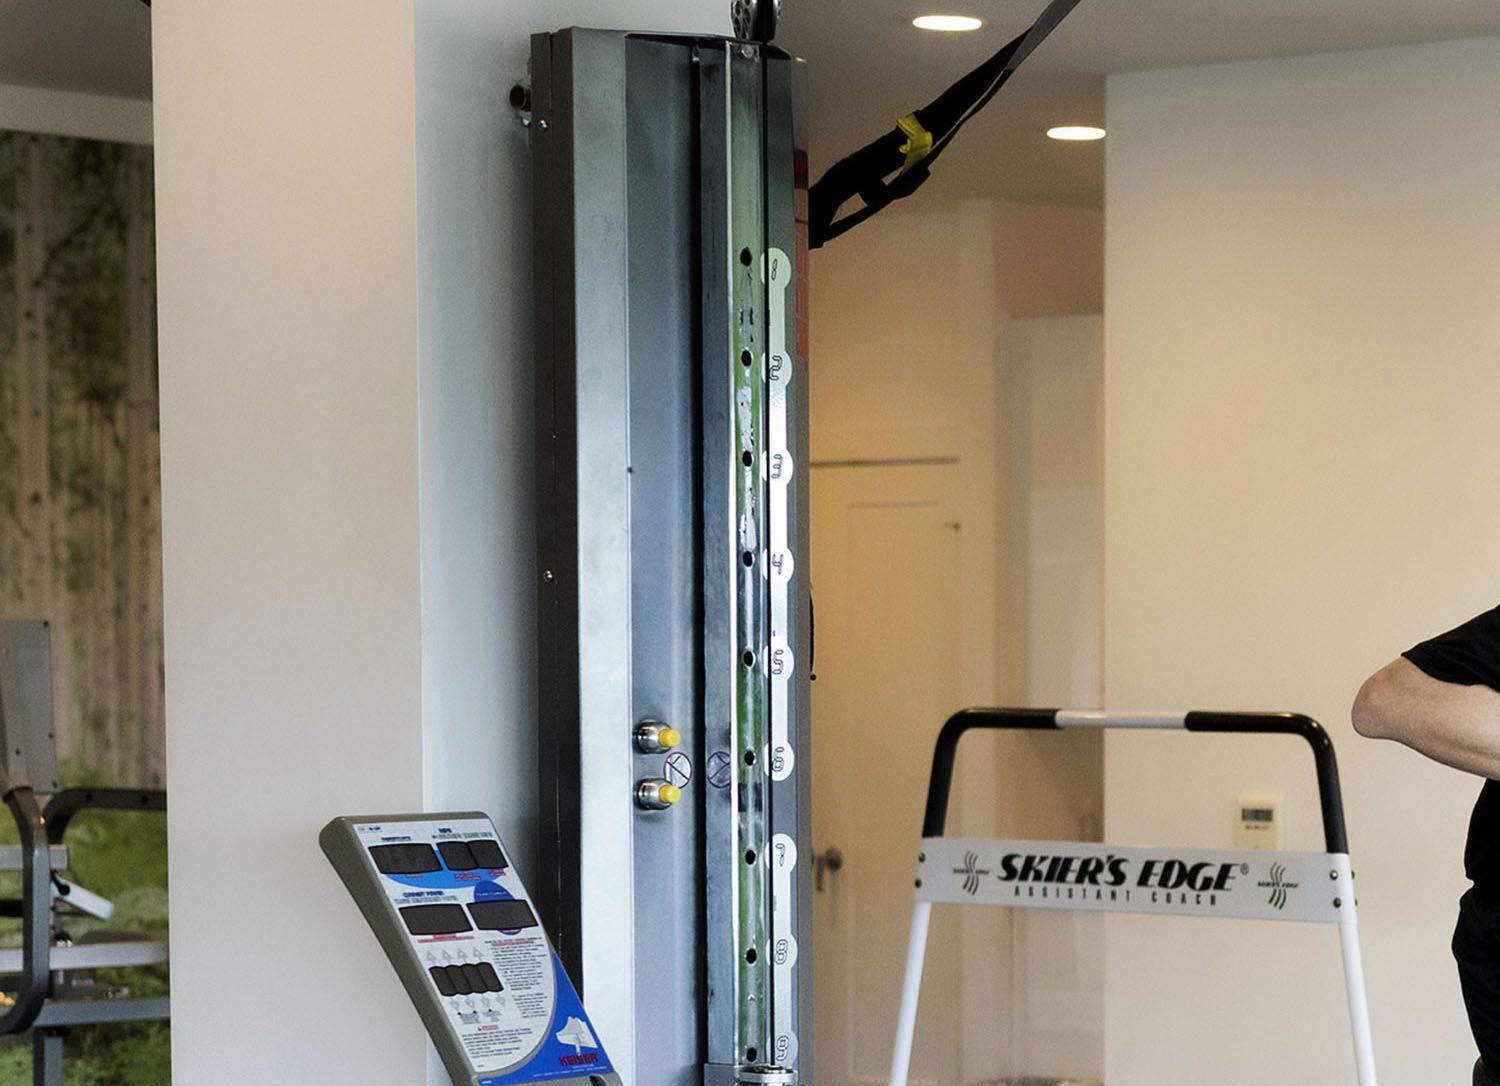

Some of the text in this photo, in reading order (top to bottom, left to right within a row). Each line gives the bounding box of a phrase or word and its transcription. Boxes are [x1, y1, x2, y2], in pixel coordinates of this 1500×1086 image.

[769, 354, 784, 382] 2
[771, 648, 785, 675] 5
[771, 746, 785, 773] 6
[775, 842, 786, 867] 7
[996, 852, 1131, 887] SKIER'S
[1151, 891, 1217, 906] COACH
[775, 938, 789, 965] 8
[775, 1034, 790, 1062] 9
